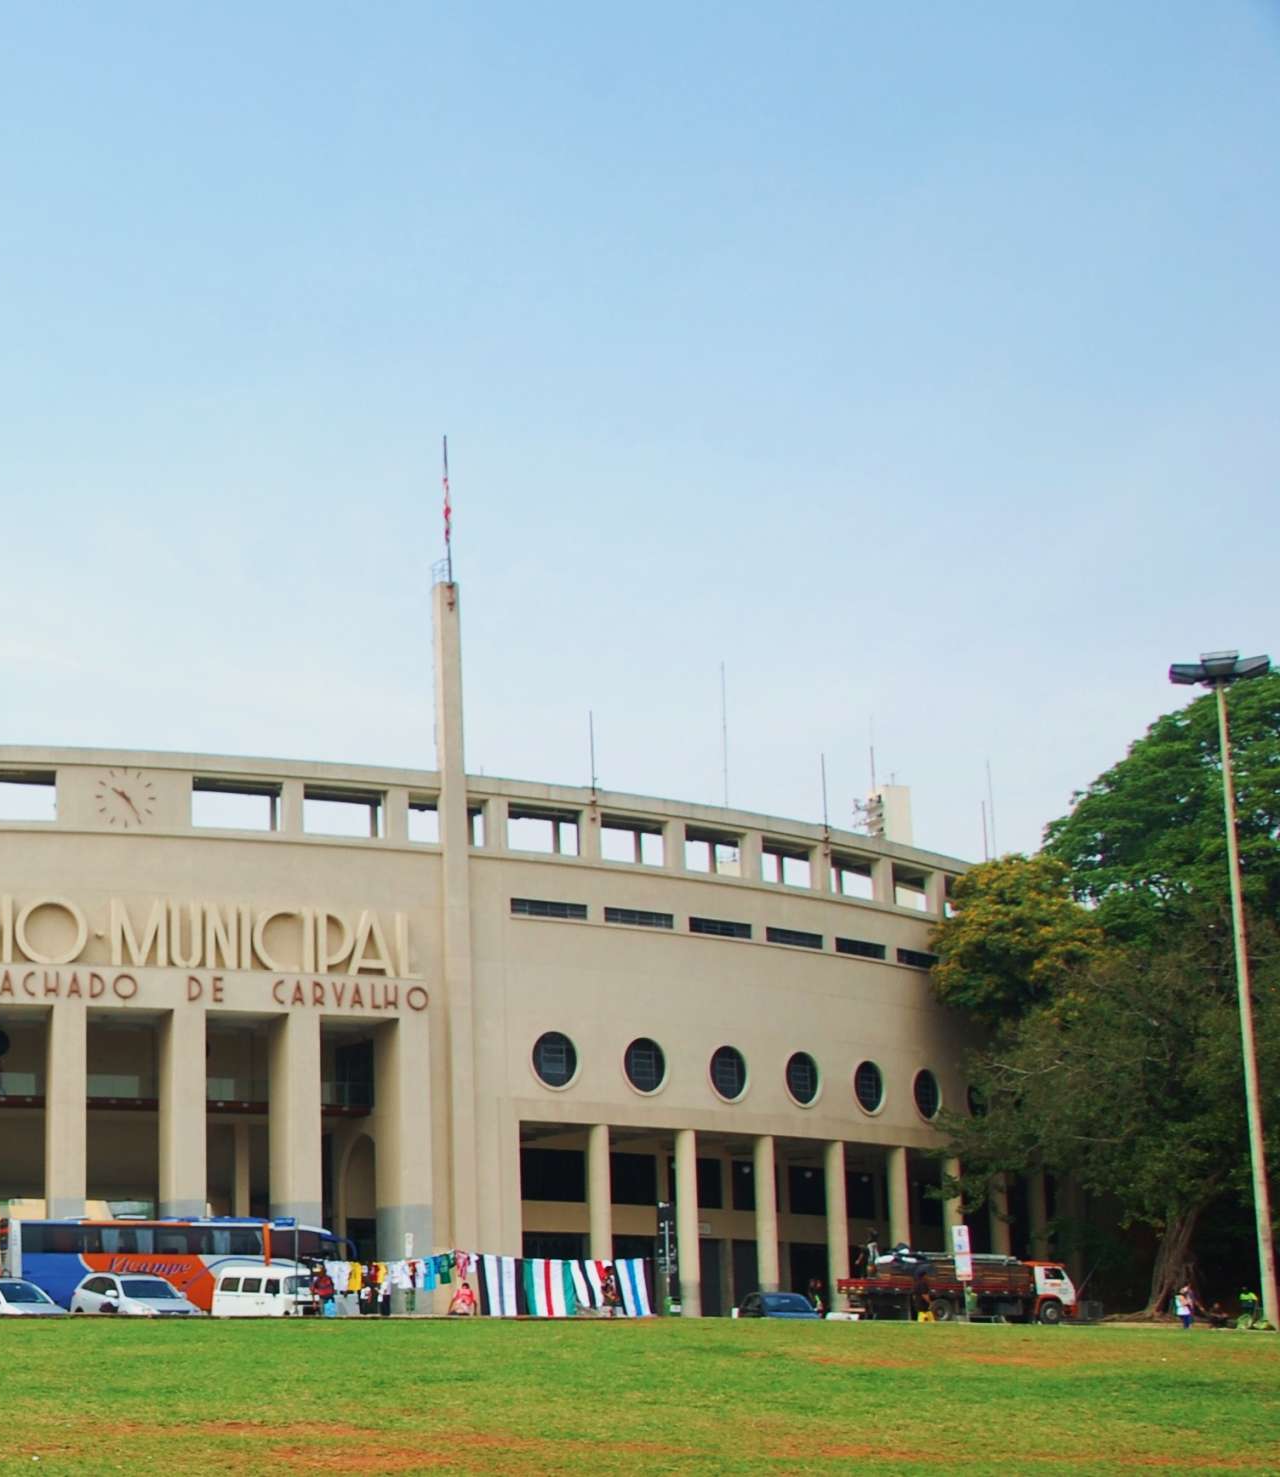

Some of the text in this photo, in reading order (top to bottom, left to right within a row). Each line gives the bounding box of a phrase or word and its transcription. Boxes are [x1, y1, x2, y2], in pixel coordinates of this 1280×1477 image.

[110, 897, 424, 979] MUNICIPAL
[187, 975, 224, 1002] DE
[272, 979, 429, 1012] CARVALHO
